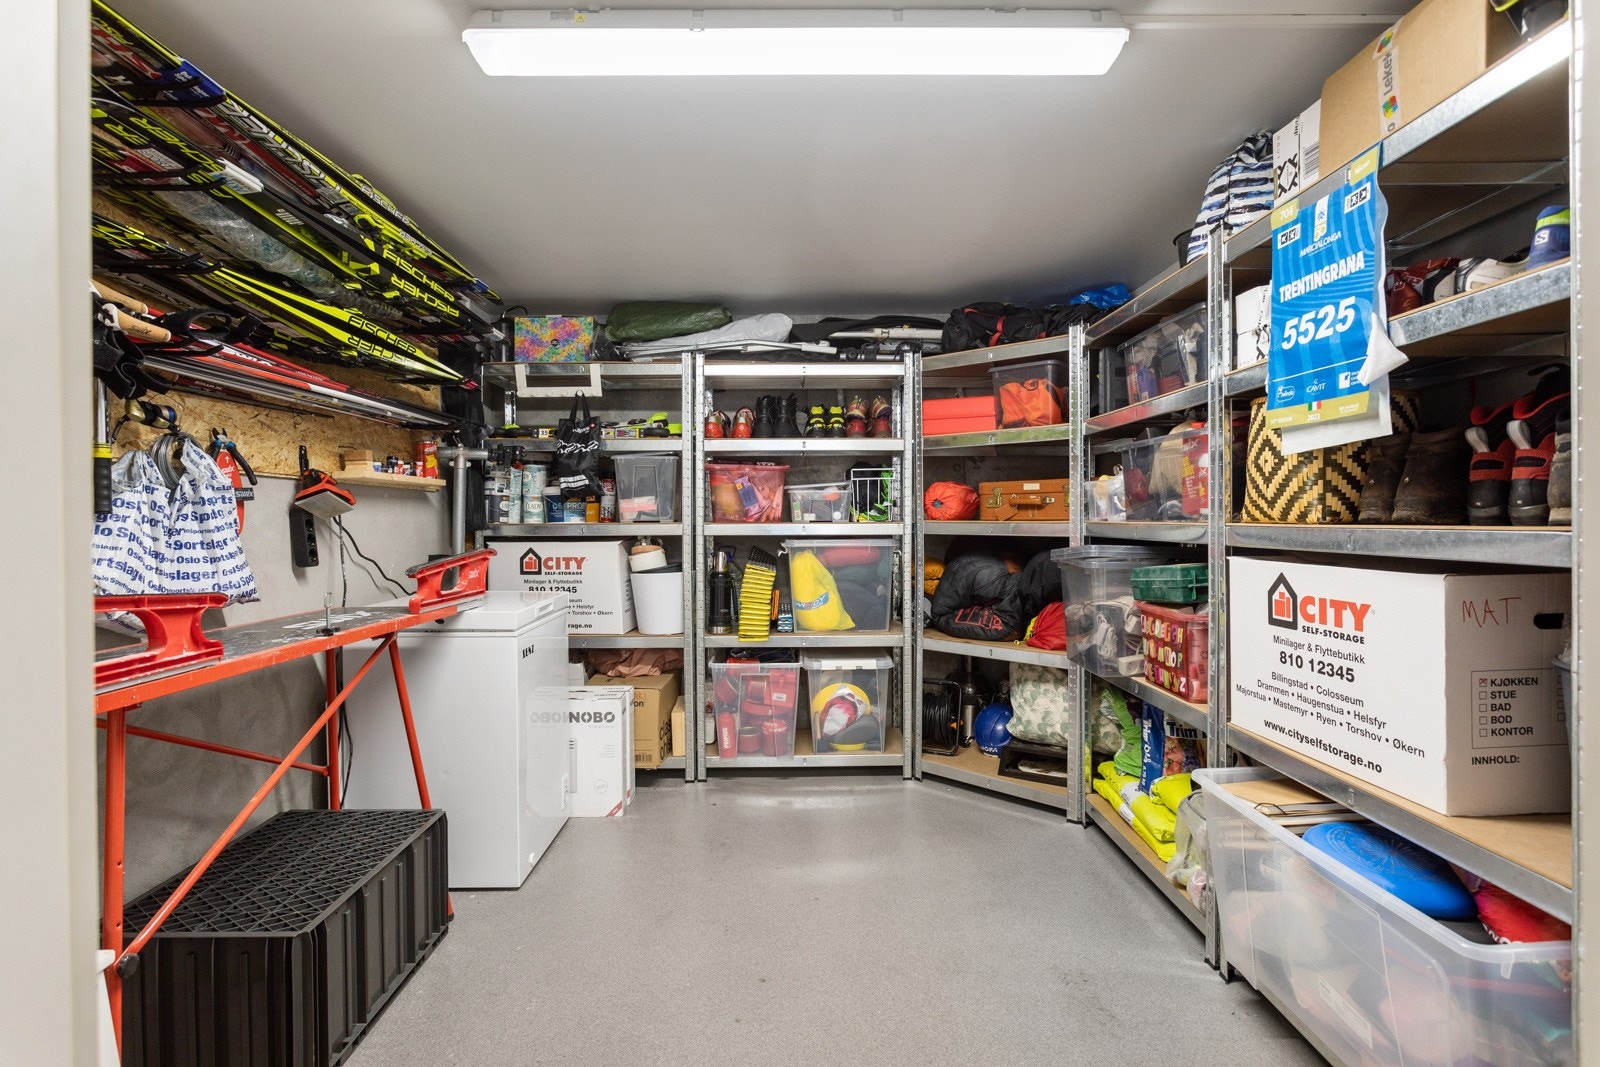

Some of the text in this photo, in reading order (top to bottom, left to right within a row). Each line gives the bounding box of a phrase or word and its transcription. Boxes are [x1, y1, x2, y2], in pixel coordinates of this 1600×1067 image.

[361, 185, 411, 225] FISCHER
[1300, 231, 1342, 258] MARCIALONGA
[382, 247, 455, 303] FISCHER
[1279, 250, 1366, 304] TRENTINGRANA
[390, 273, 460, 318] FISCHER
[348, 315, 417, 354] FISCHER
[1281, 295, 1356, 350] 5525
[1306, 383, 1327, 393] CAVIT
[542, 556, 586, 570] CITY
[1299, 595, 1372, 633] CITY
[1462, 596, 1522, 628] MAT
[1273, 634, 1366, 665] Minilager & Flyttebutikk
[1302, 625, 1365, 645] SELF-STORAGE
[1279, 650, 1355, 684] 810 12345
[1490, 677, 1539, 687] KJØKKEN
[1257, 679, 1387, 730] Drammen Haugenstua Helsfyr
[1271, 671, 1364, 708] Billingstad Colosseum
[1490, 690, 1517, 699] STUE
[569, 711, 616, 723] NOBO
[1236, 683, 1425, 759] Majorstua Mastemyr Ryen Torshov Økern
[1490, 703, 1512, 712] BAD
[1490, 715, 1513, 724] BOD
[1167, 722, 1198, 738] Trim
[1490, 727, 1534, 737] KONTOR
[1263, 719, 1383, 773] www.cityselfstorage.no
[1471, 755, 1520, 766] INNHOLD:
